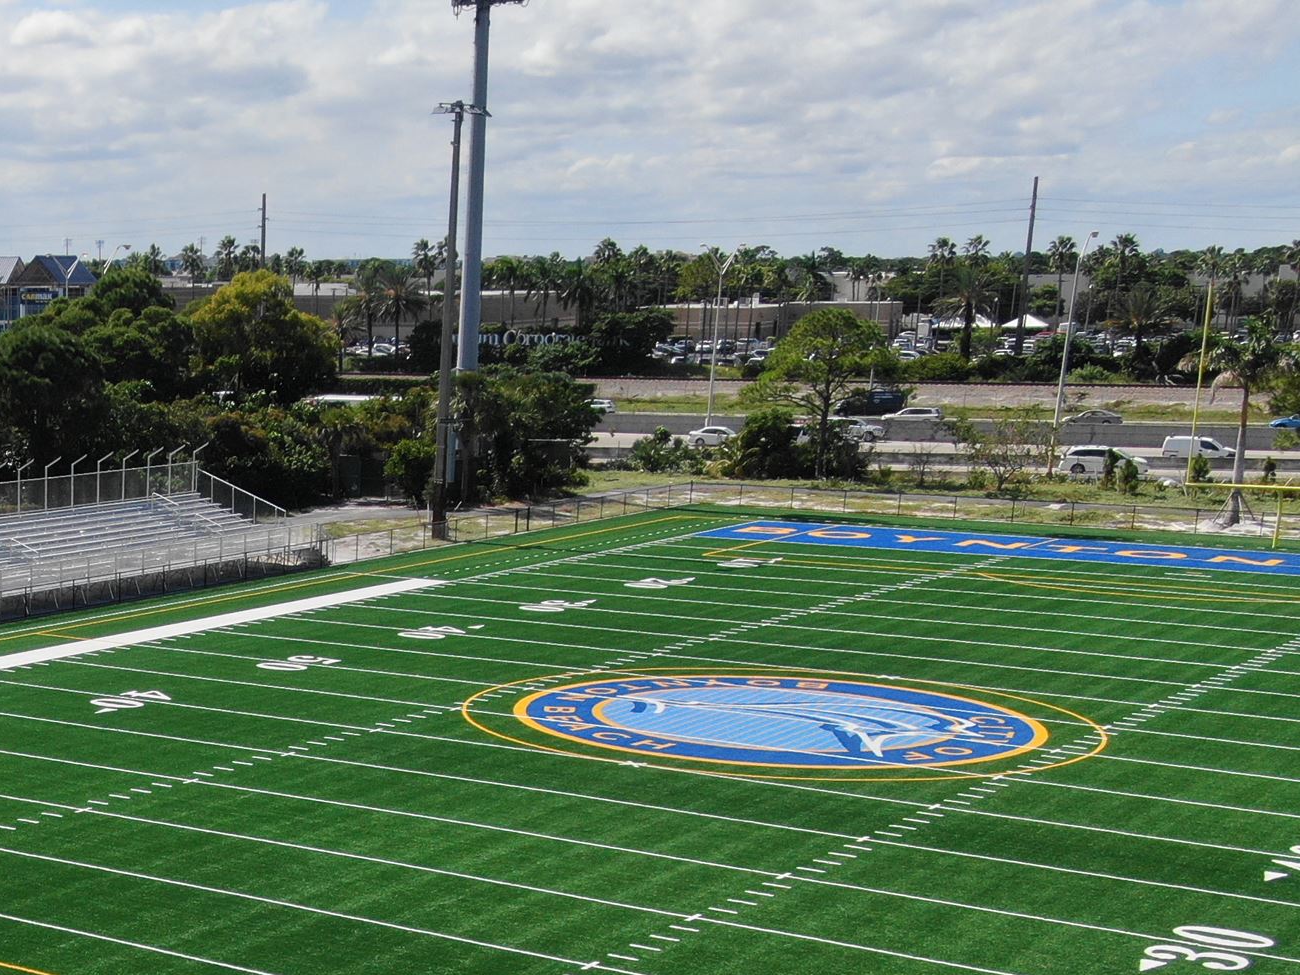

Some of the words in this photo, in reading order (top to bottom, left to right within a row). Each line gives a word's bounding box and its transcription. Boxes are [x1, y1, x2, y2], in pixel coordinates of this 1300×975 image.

[733, 526, 1286, 567] BOYNTON
[624, 577, 688, 589] 20
[519, 599, 590, 612] 30
[398, 625, 467, 640] 40
[256, 654, 343, 672] 50
[99, 688, 172, 710] 40
[556, 679, 828, 702] BOYNTON
[543, 705, 676, 750] BEACH
[902, 746, 973, 761] OF
[1144, 925, 1275, 971] 30
